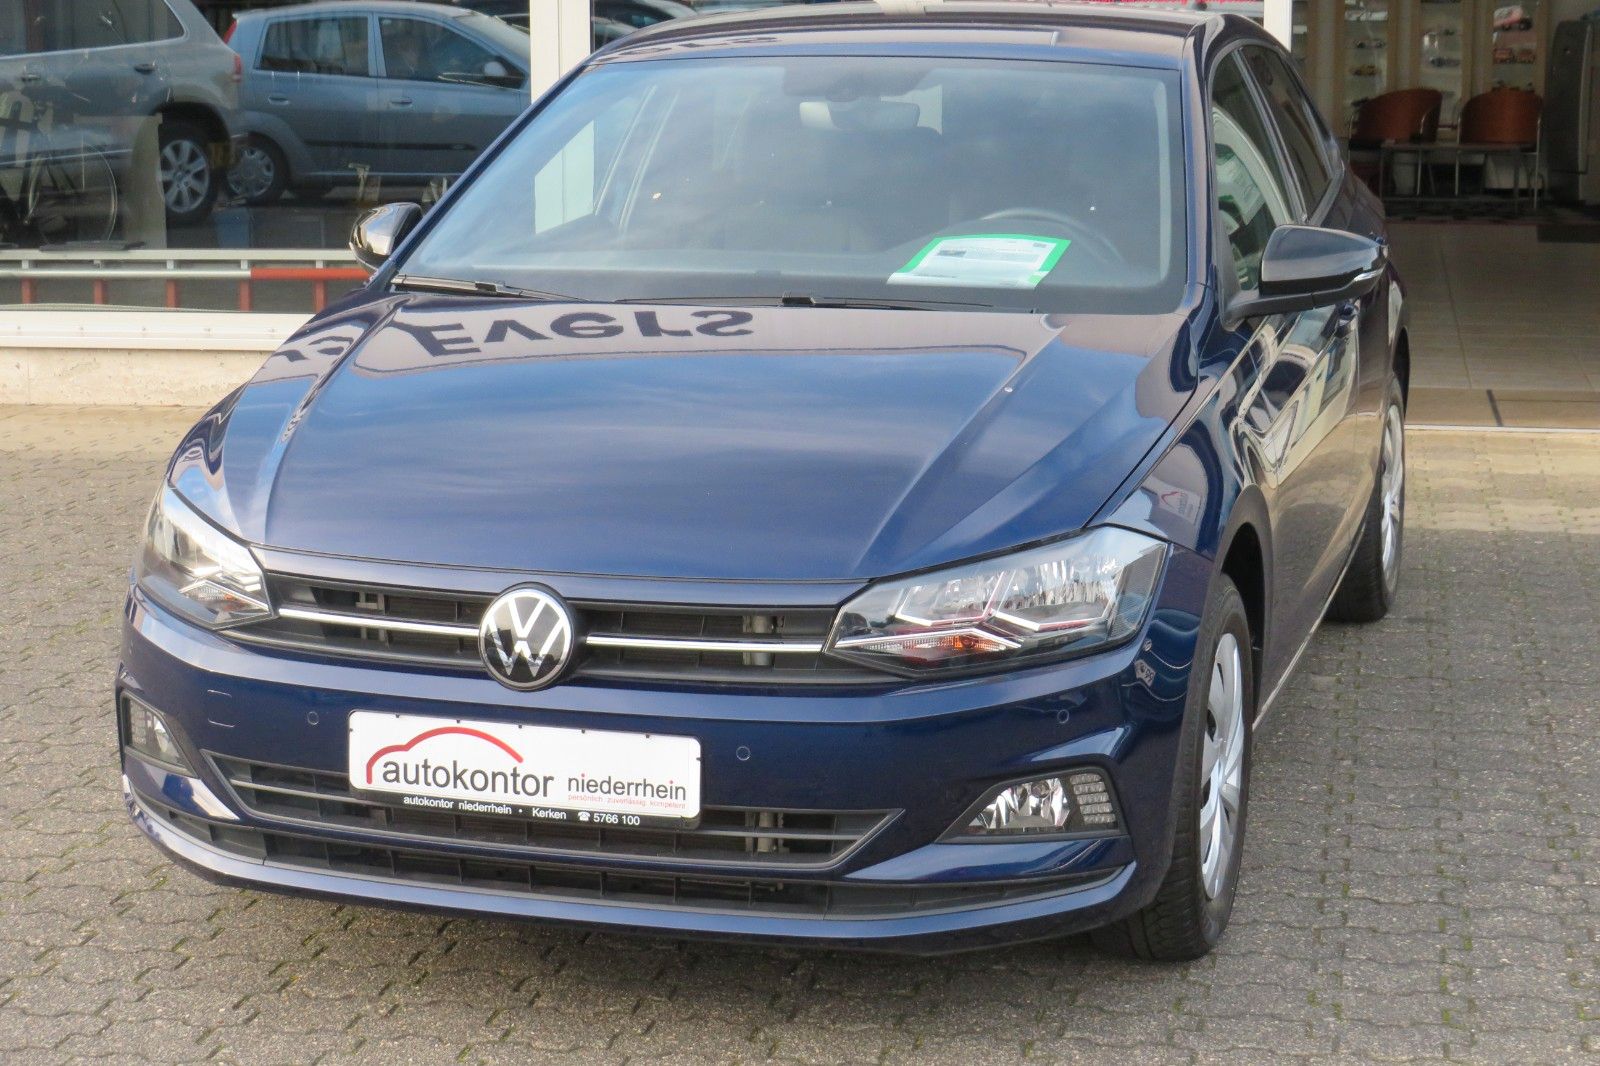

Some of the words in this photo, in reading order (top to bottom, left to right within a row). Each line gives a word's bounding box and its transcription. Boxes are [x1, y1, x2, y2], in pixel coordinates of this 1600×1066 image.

[382, 758, 555, 797] autokontor
[568, 773, 686, 800] niederrhein
[403, 795, 454, 809] autokontor
[458, 800, 512, 815] niederrhein
[532, 807, 567, 820] Kerken
[593, 812, 618, 824] 5766
[622, 814, 641, 826] 100
